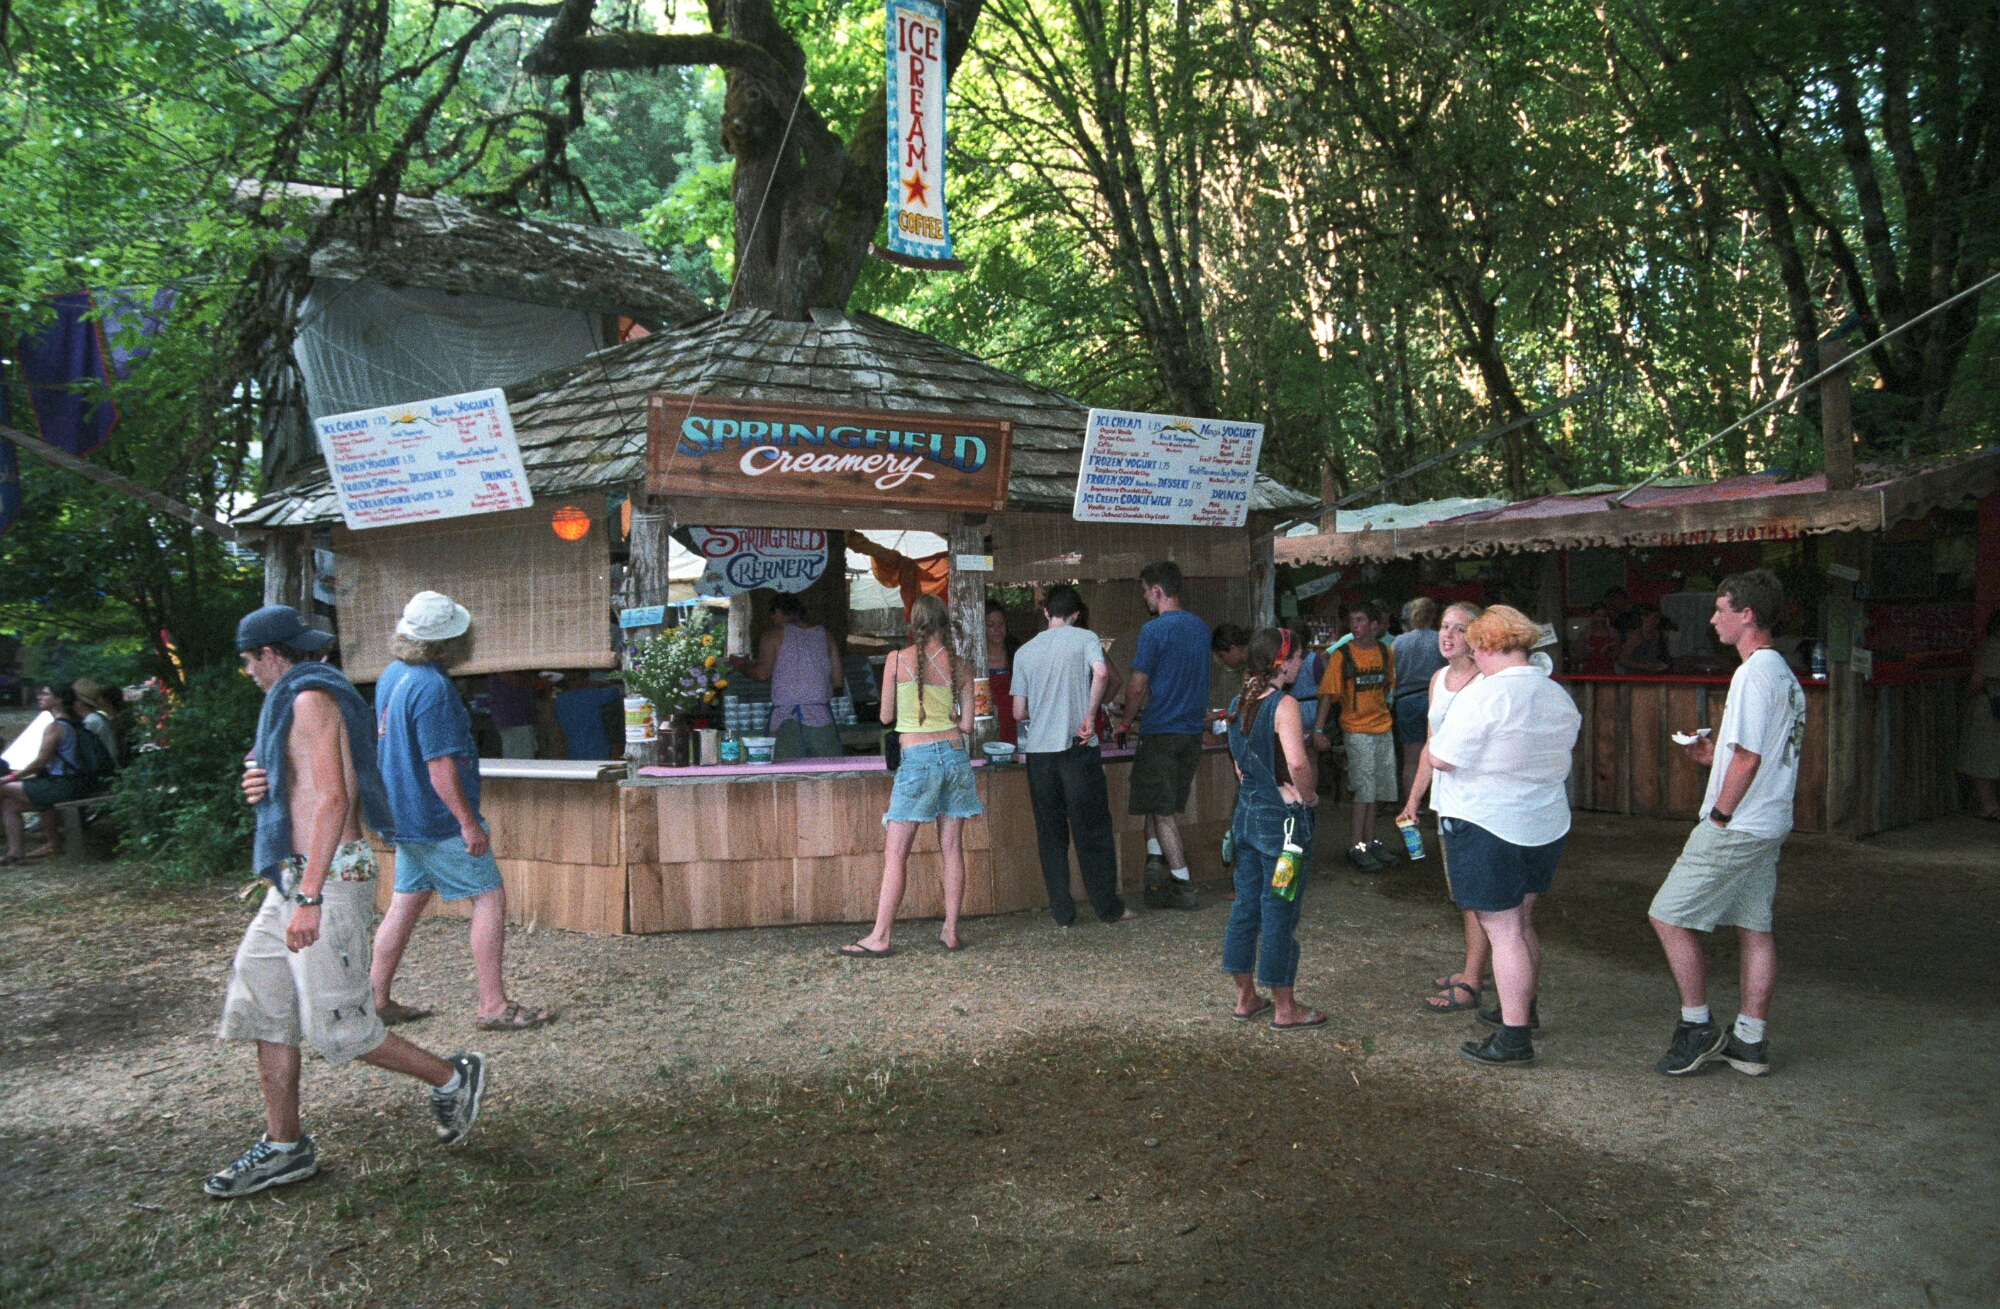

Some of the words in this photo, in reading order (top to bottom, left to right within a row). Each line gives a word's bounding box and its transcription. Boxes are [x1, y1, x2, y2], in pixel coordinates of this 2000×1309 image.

[898, 17, 939, 61] ICE
[899, 210, 945, 240] COFFEE
[454, 398, 495, 413] YOGURT
[321, 423, 336, 435] ICE
[336, 419, 368, 432] CREAM
[1097, 416, 1109, 427] ICE
[1111, 417, 1142, 429] CREAM
[1222, 426, 1257, 439] YOGURT
[676, 415, 987, 473] SPRINGFIELD
[335, 462, 365, 474] FROZEN
[365, 457, 400, 469] YOGURT
[740, 445, 935, 490] Creamery
[1089, 455, 1124, 467] FROZEN
[1125, 457, 1158, 469] YOGURT
[341, 481, 372, 493] FROZEN
[371, 478, 388, 488] SOY
[409, 470, 442, 484] DESSERT
[480, 469, 514, 482] DRINKS
[1086, 474, 1117, 485] FROZEN
[1118, 476, 1135, 486] SOY
[1158, 477, 1190, 490] DESSERT
[1178, 498, 1194, 507] 2.50
[1211, 489, 1247, 501] DRINKS
[701, 526, 825, 558] SPRINGFIELD
[1660, 530, 1718, 548] BLINTZ
[726, 553, 825, 588] CREAMERY
